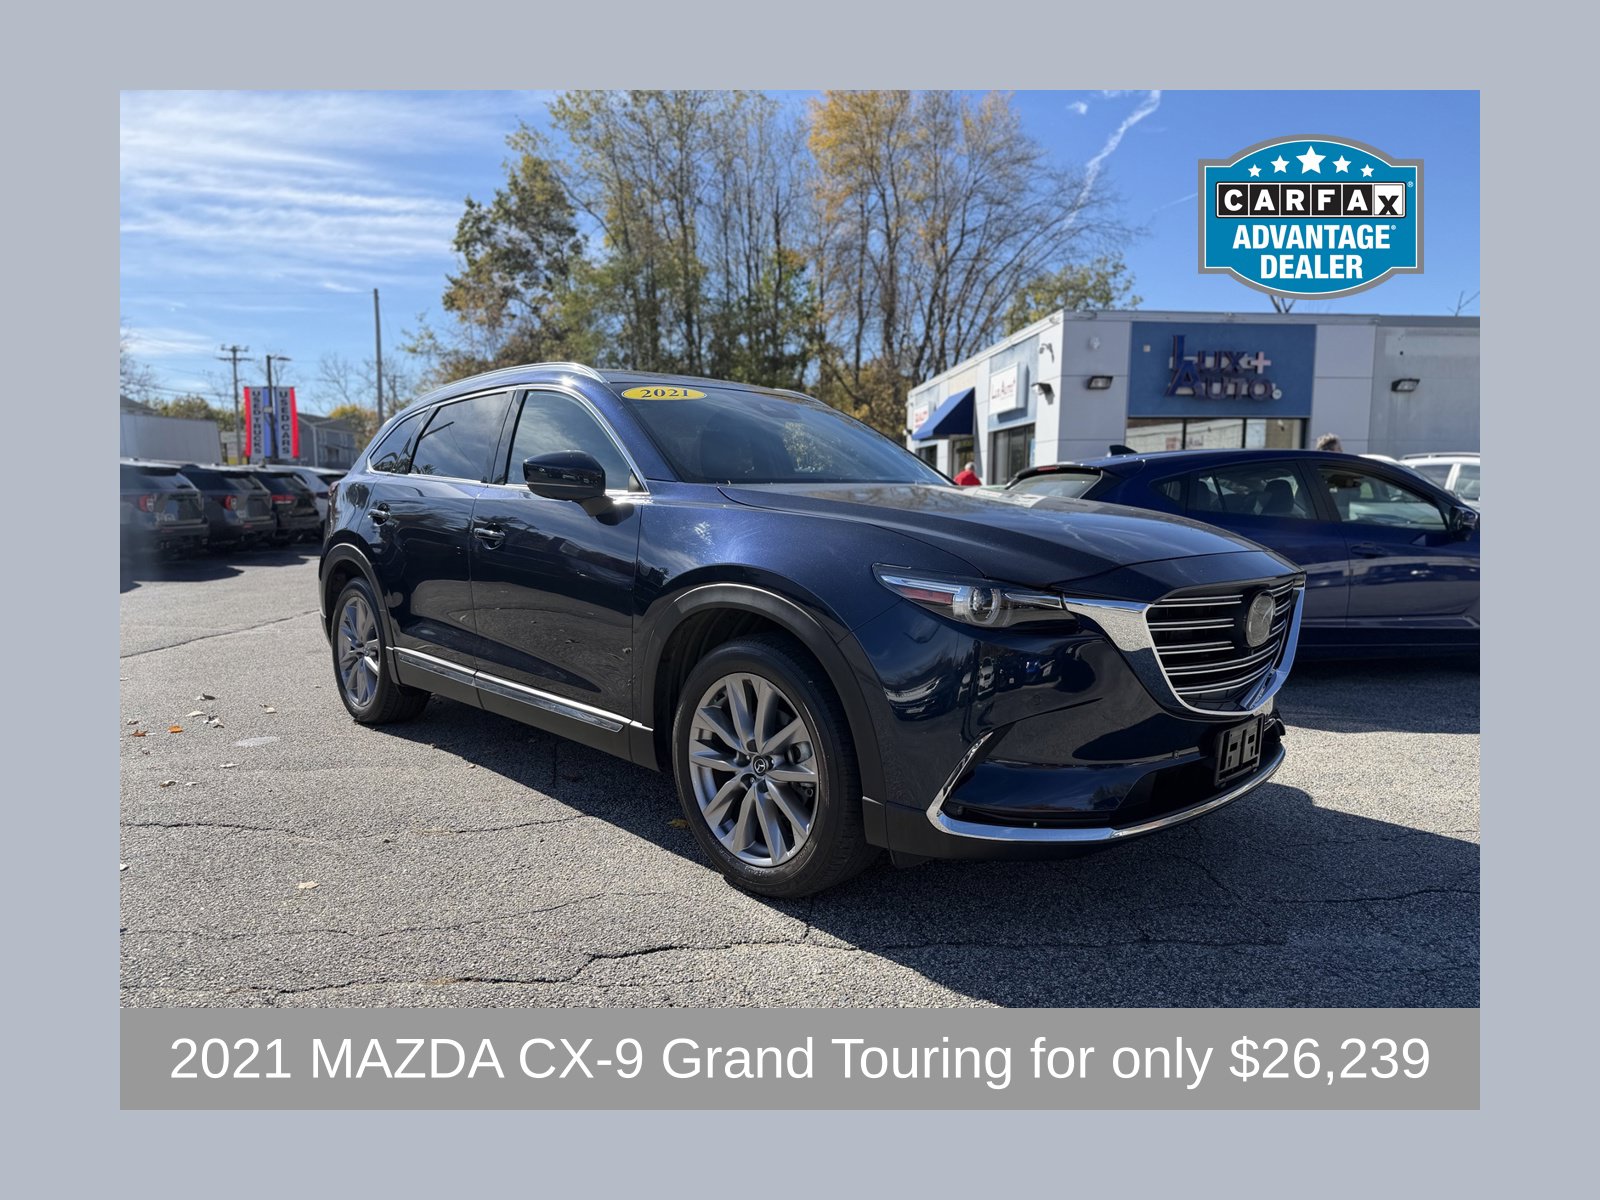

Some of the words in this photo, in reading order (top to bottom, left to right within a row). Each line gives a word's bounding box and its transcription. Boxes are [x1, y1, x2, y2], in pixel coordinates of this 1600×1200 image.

[279, 390, 290, 422] USED
[640, 388, 689, 398] 2021
[280, 423, 291, 455] CARS
